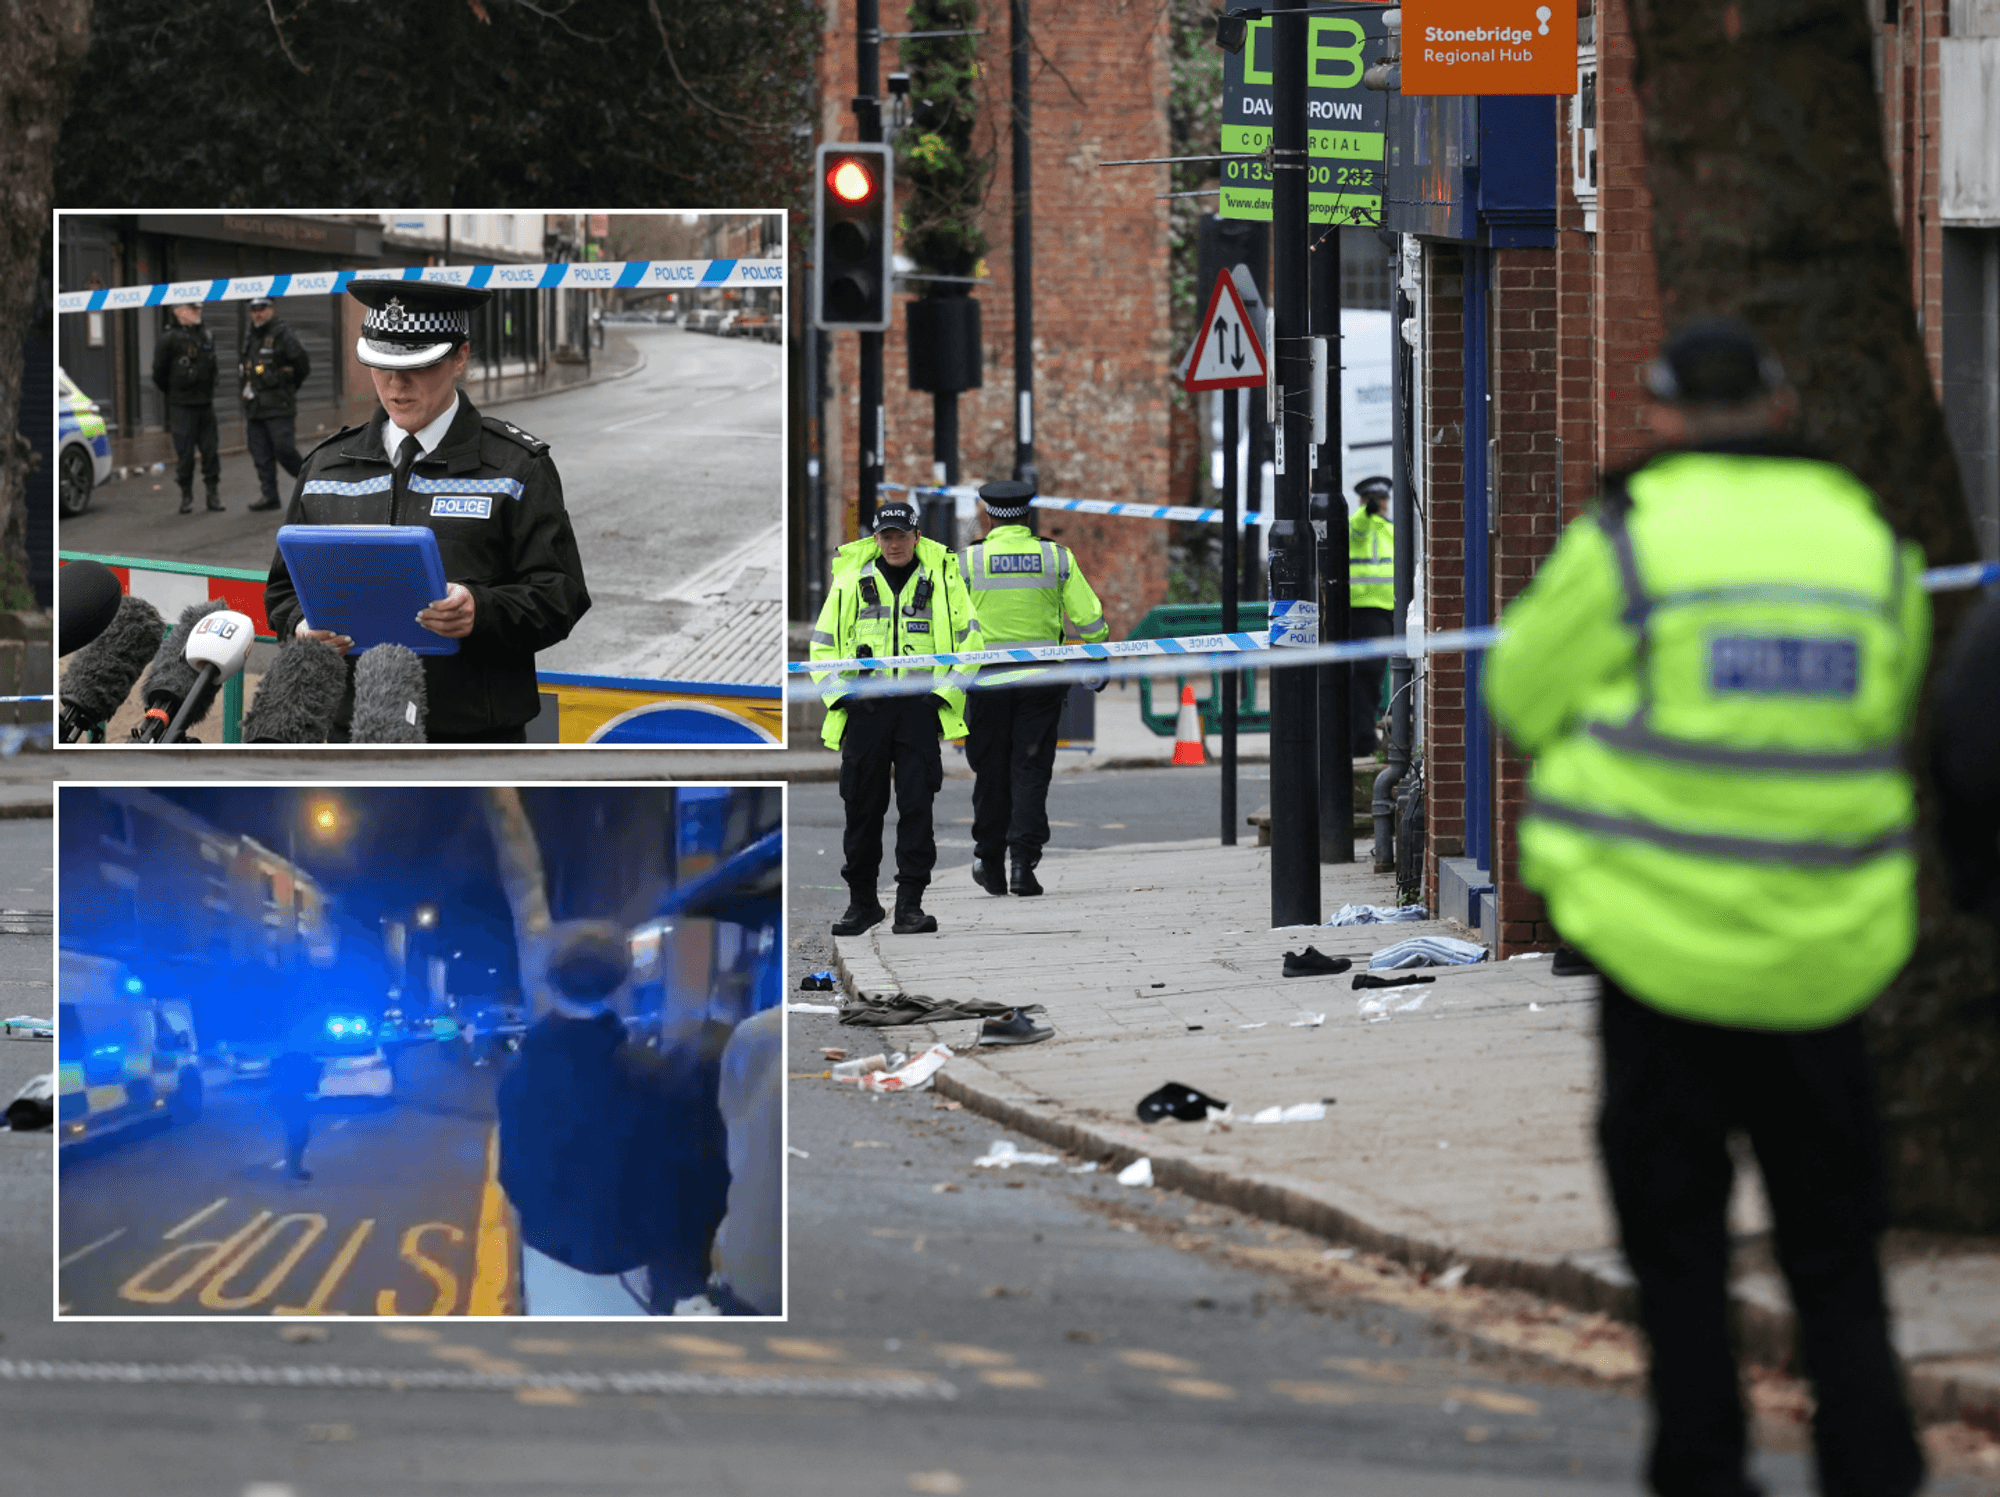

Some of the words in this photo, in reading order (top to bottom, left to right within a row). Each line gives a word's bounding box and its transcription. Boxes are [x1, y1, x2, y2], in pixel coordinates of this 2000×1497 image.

[1425, 26, 1533, 45] Stonebridge
[1424, 48, 1495, 65] Regional
[1499, 48, 1533, 62] Hub
[1242, 97, 1273, 116] DAV
[1307, 101, 1363, 120] ROWN
[1241, 132, 1361, 152] COMRCIAL
[234, 281, 264, 294] POLICE
[296, 277, 327, 290] POLICE
[499, 269, 535, 282] POLICE
[574, 268, 611, 281] POLICE
[655, 266, 695, 281] POLICE
[741, 266, 783, 280] POLICE
[437, 499, 487, 514] POLICE
[881, 509, 907, 518] POLICE
[991, 554, 1042, 573] POLICE
[197, 618, 239, 639] LBC
[908, 622, 929, 632] POLICE
[1290, 633, 1317, 644] POLIC
